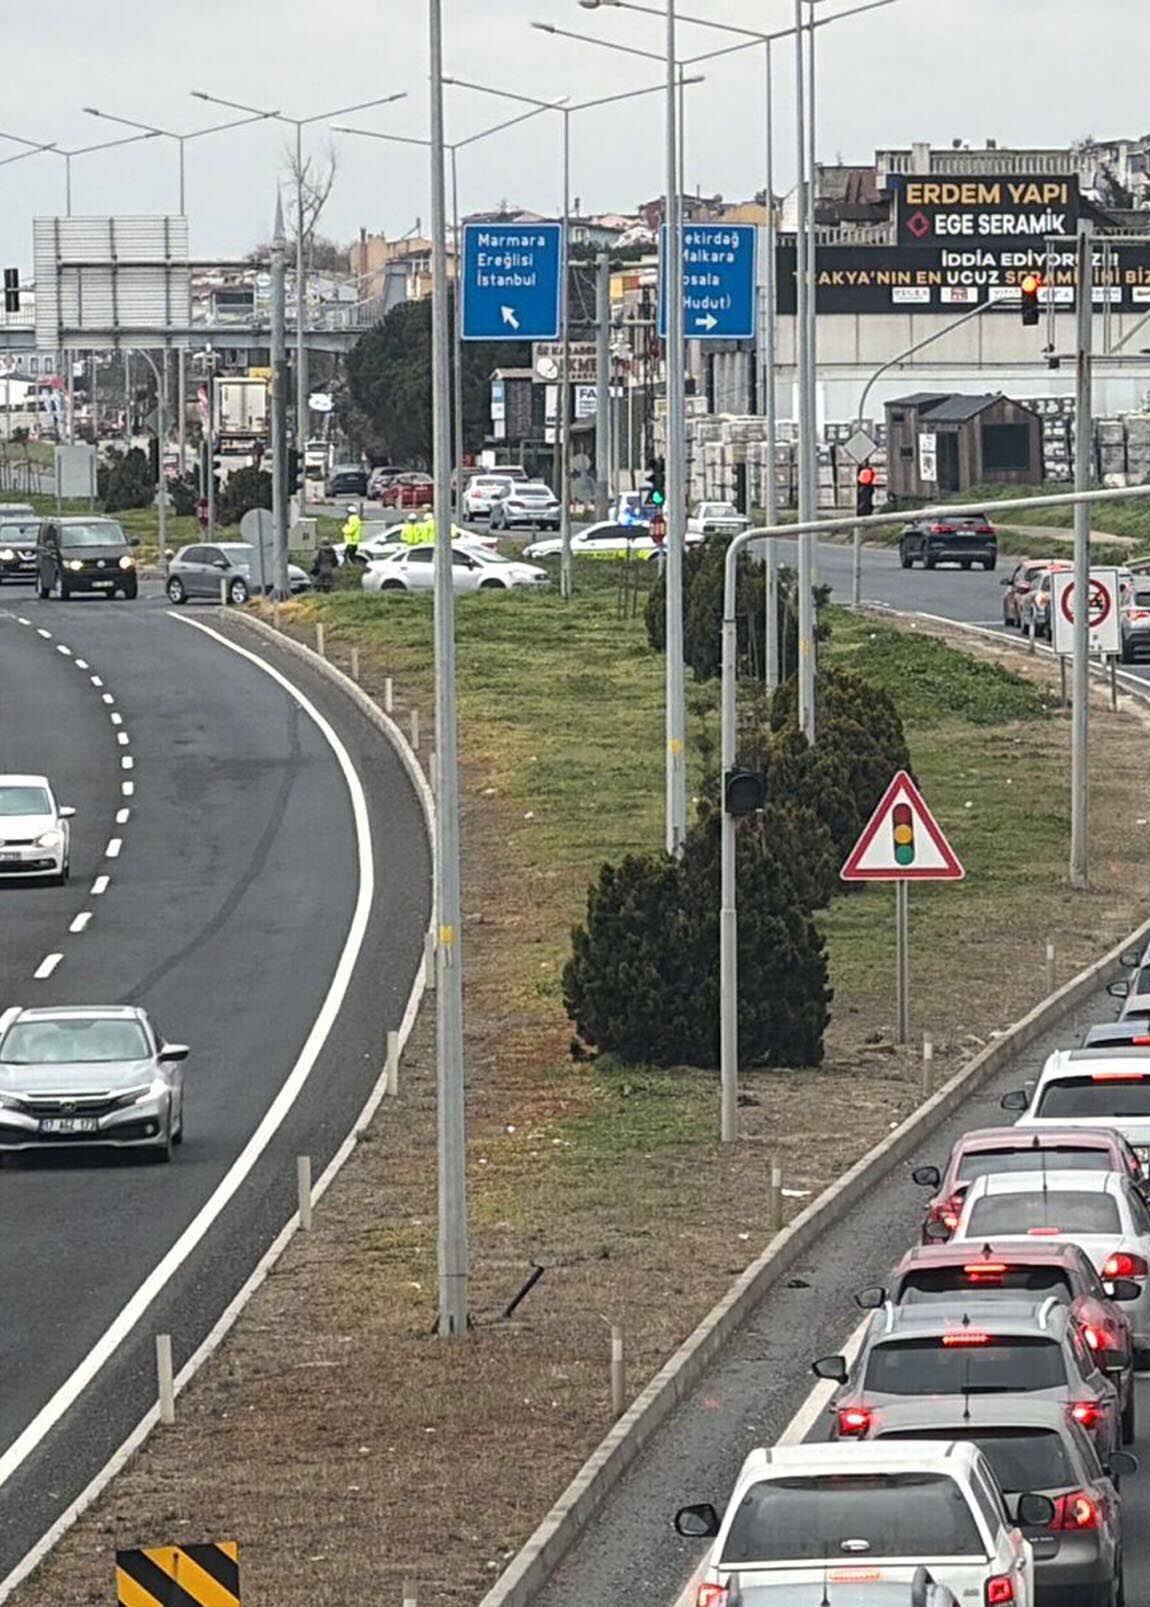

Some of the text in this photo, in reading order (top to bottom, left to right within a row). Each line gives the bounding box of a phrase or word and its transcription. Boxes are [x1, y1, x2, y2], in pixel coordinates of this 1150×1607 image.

[906, 183, 1068, 205] ERDEM YAPI
[935, 207, 1066, 235] EGE SERAMİK
[478, 233, 545, 247] Marmara
[685, 232, 739, 248] ekirdağ
[477, 252, 534, 270] Ereğlisi
[941, 249, 996, 267] İDDİA
[477, 269, 536, 286] İstanbul
[916, 270, 941, 284] EN
[946, 270, 1000, 285] UCUZ
